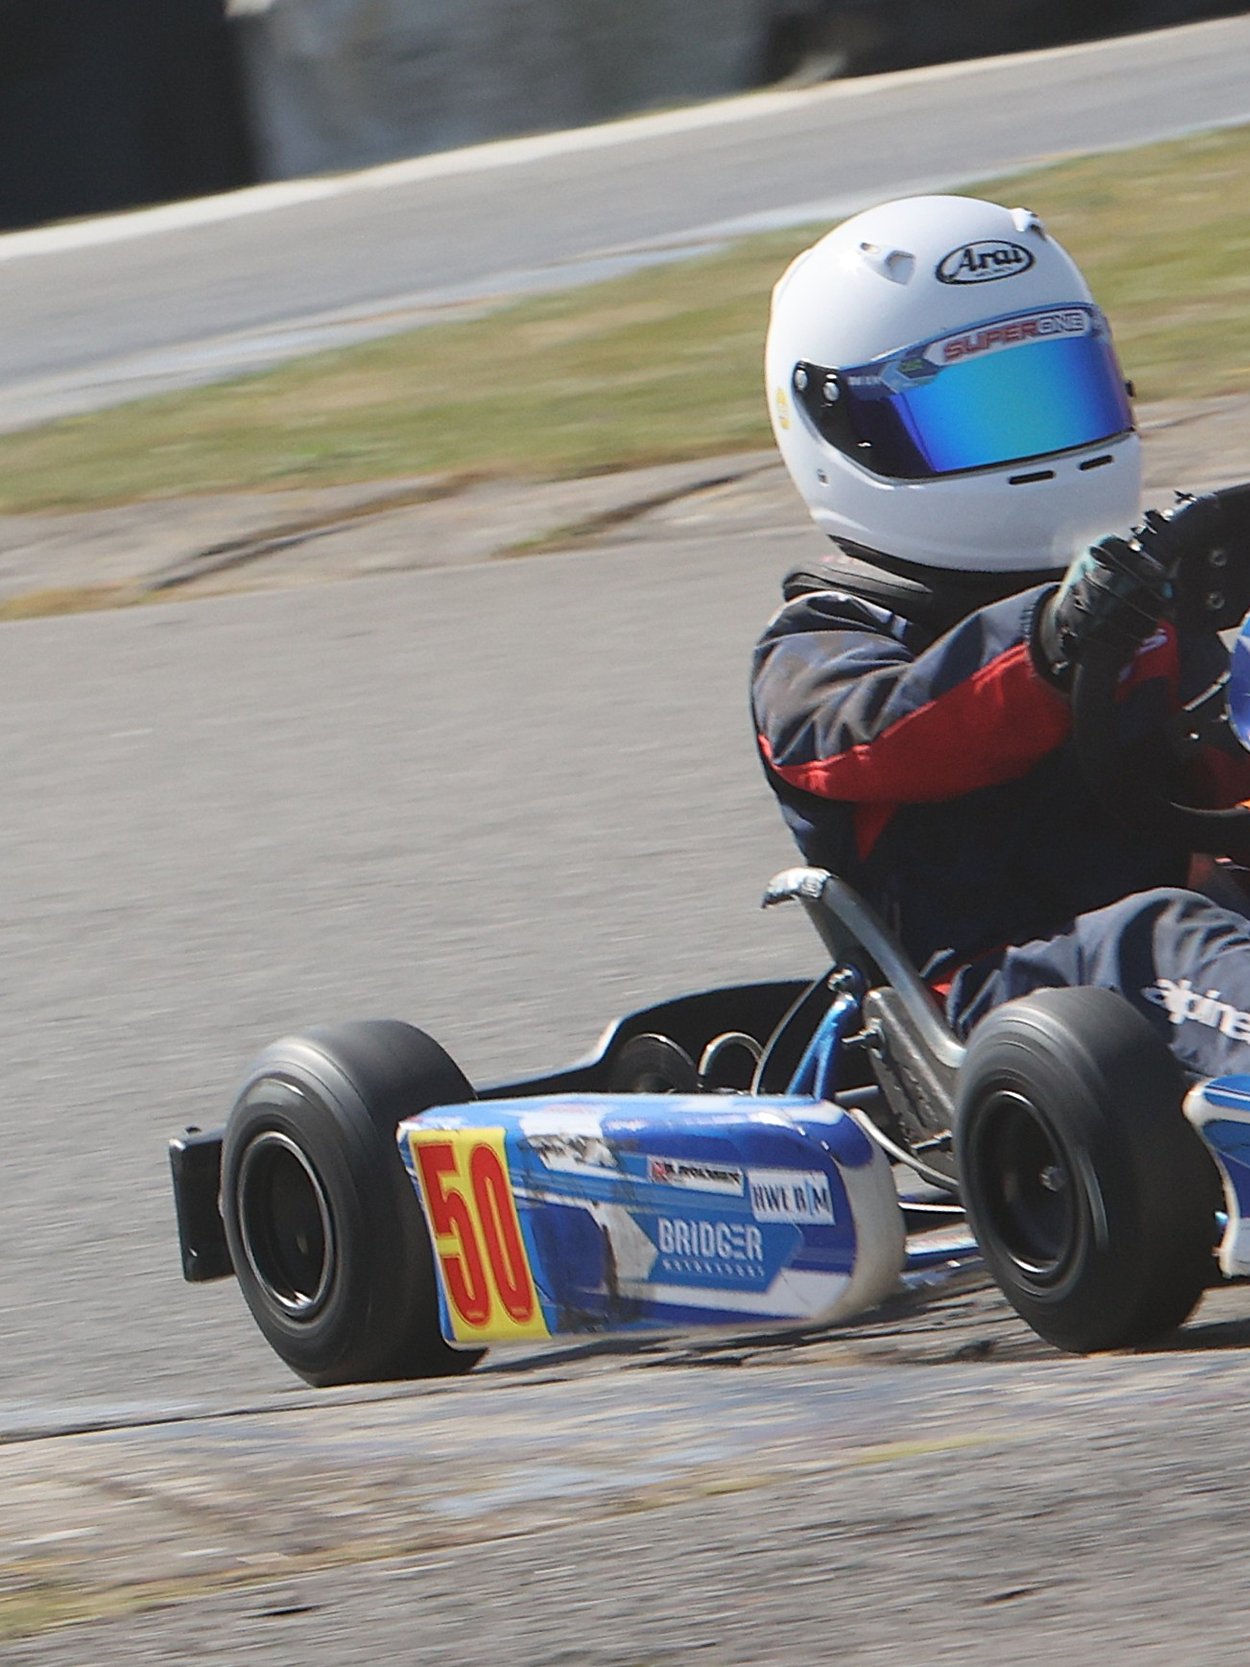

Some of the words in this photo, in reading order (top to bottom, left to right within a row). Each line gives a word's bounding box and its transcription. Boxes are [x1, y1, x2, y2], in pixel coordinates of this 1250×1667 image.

[948, 246, 1023, 278] Arai
[415, 1141, 535, 1327] 50
[657, 1216, 763, 1262] BRIDGER
